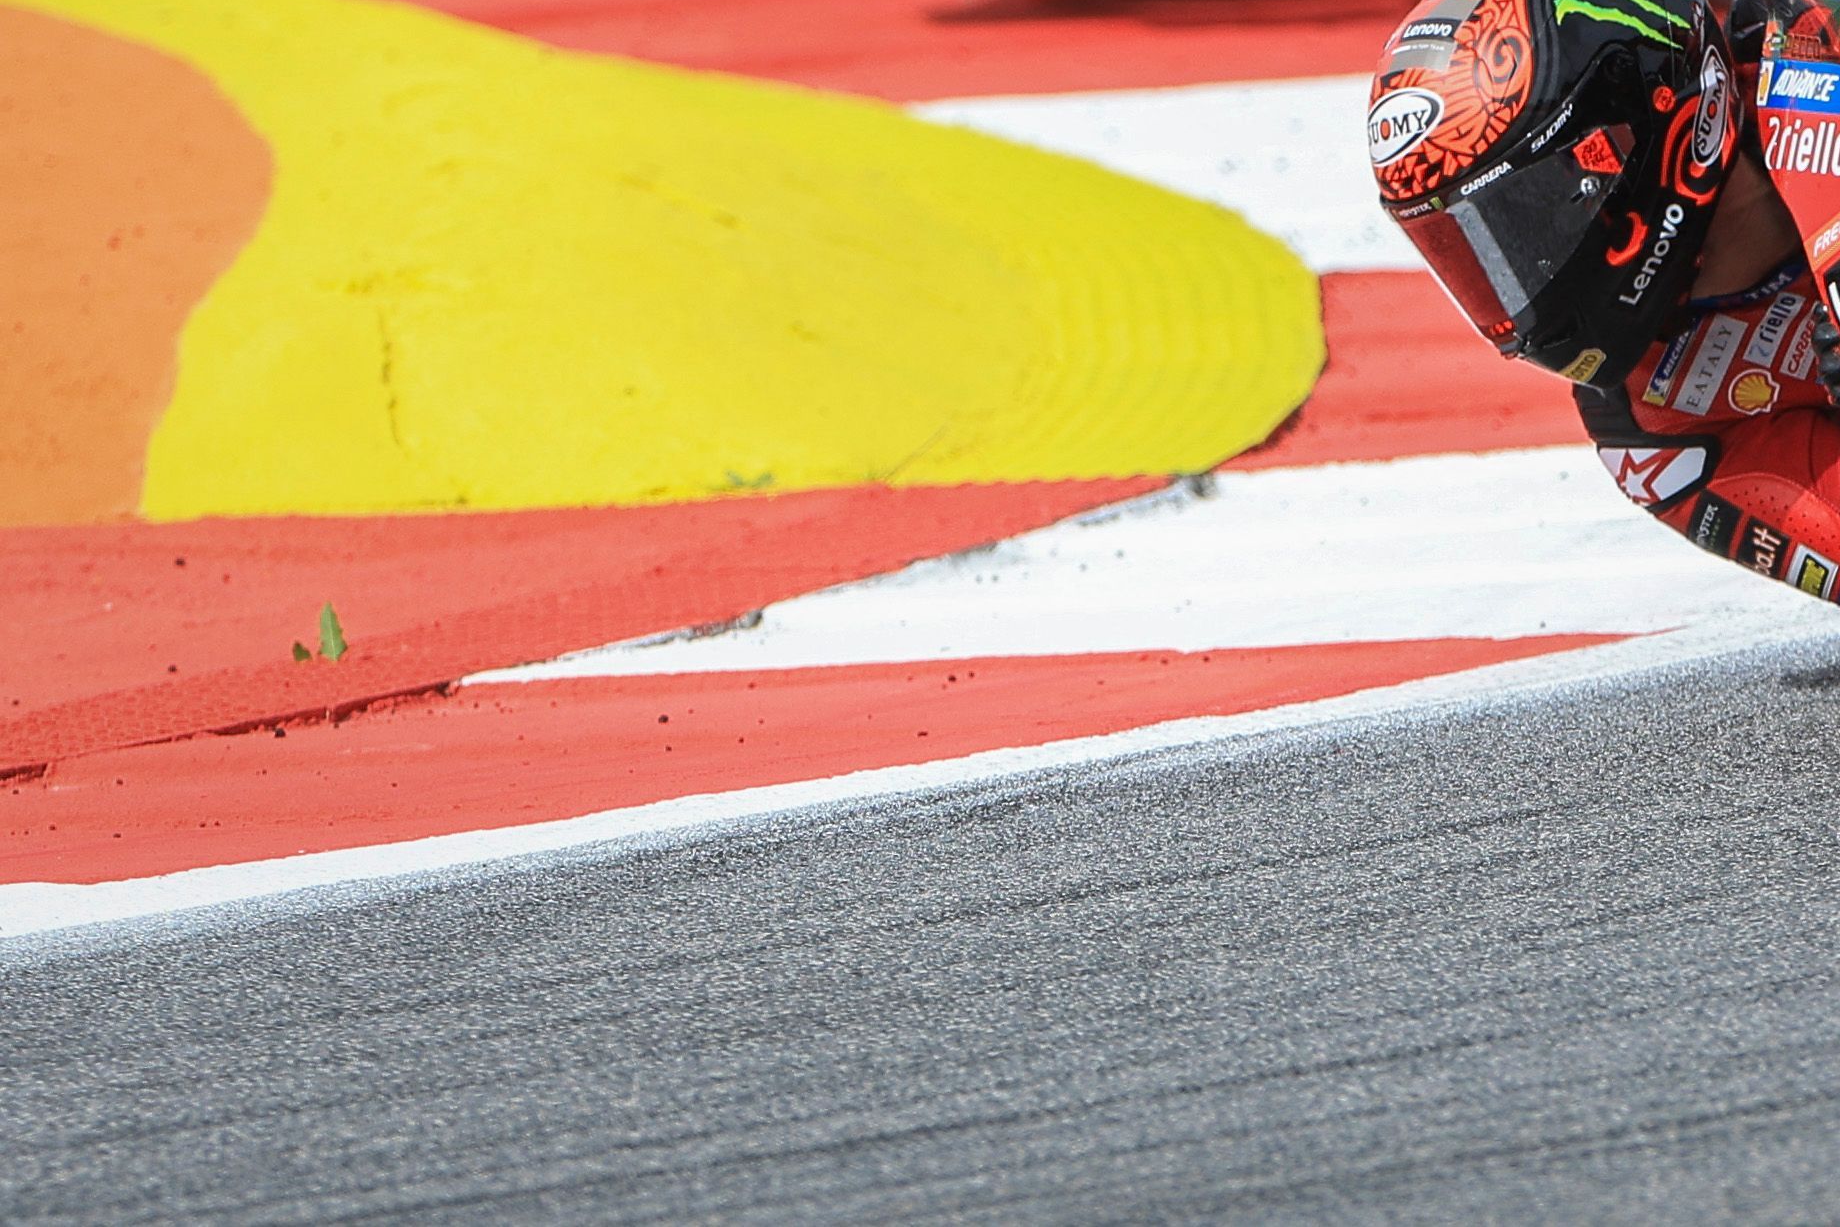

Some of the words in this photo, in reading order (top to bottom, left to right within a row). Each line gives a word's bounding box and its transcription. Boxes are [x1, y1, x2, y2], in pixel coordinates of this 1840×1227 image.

[1402, 23, 1453, 39] Lenovo
[1772, 68, 1839, 102] ADVANCE
[1530, 102, 1573, 153] SUOMY
[1460, 161, 1513, 196] CARRERA
[1619, 203, 1684, 306] Lenovo
[1760, 296, 1797, 344] riello
[1686, 324, 1733, 407] EATALY
[1788, 322, 1816, 374] CARRE
